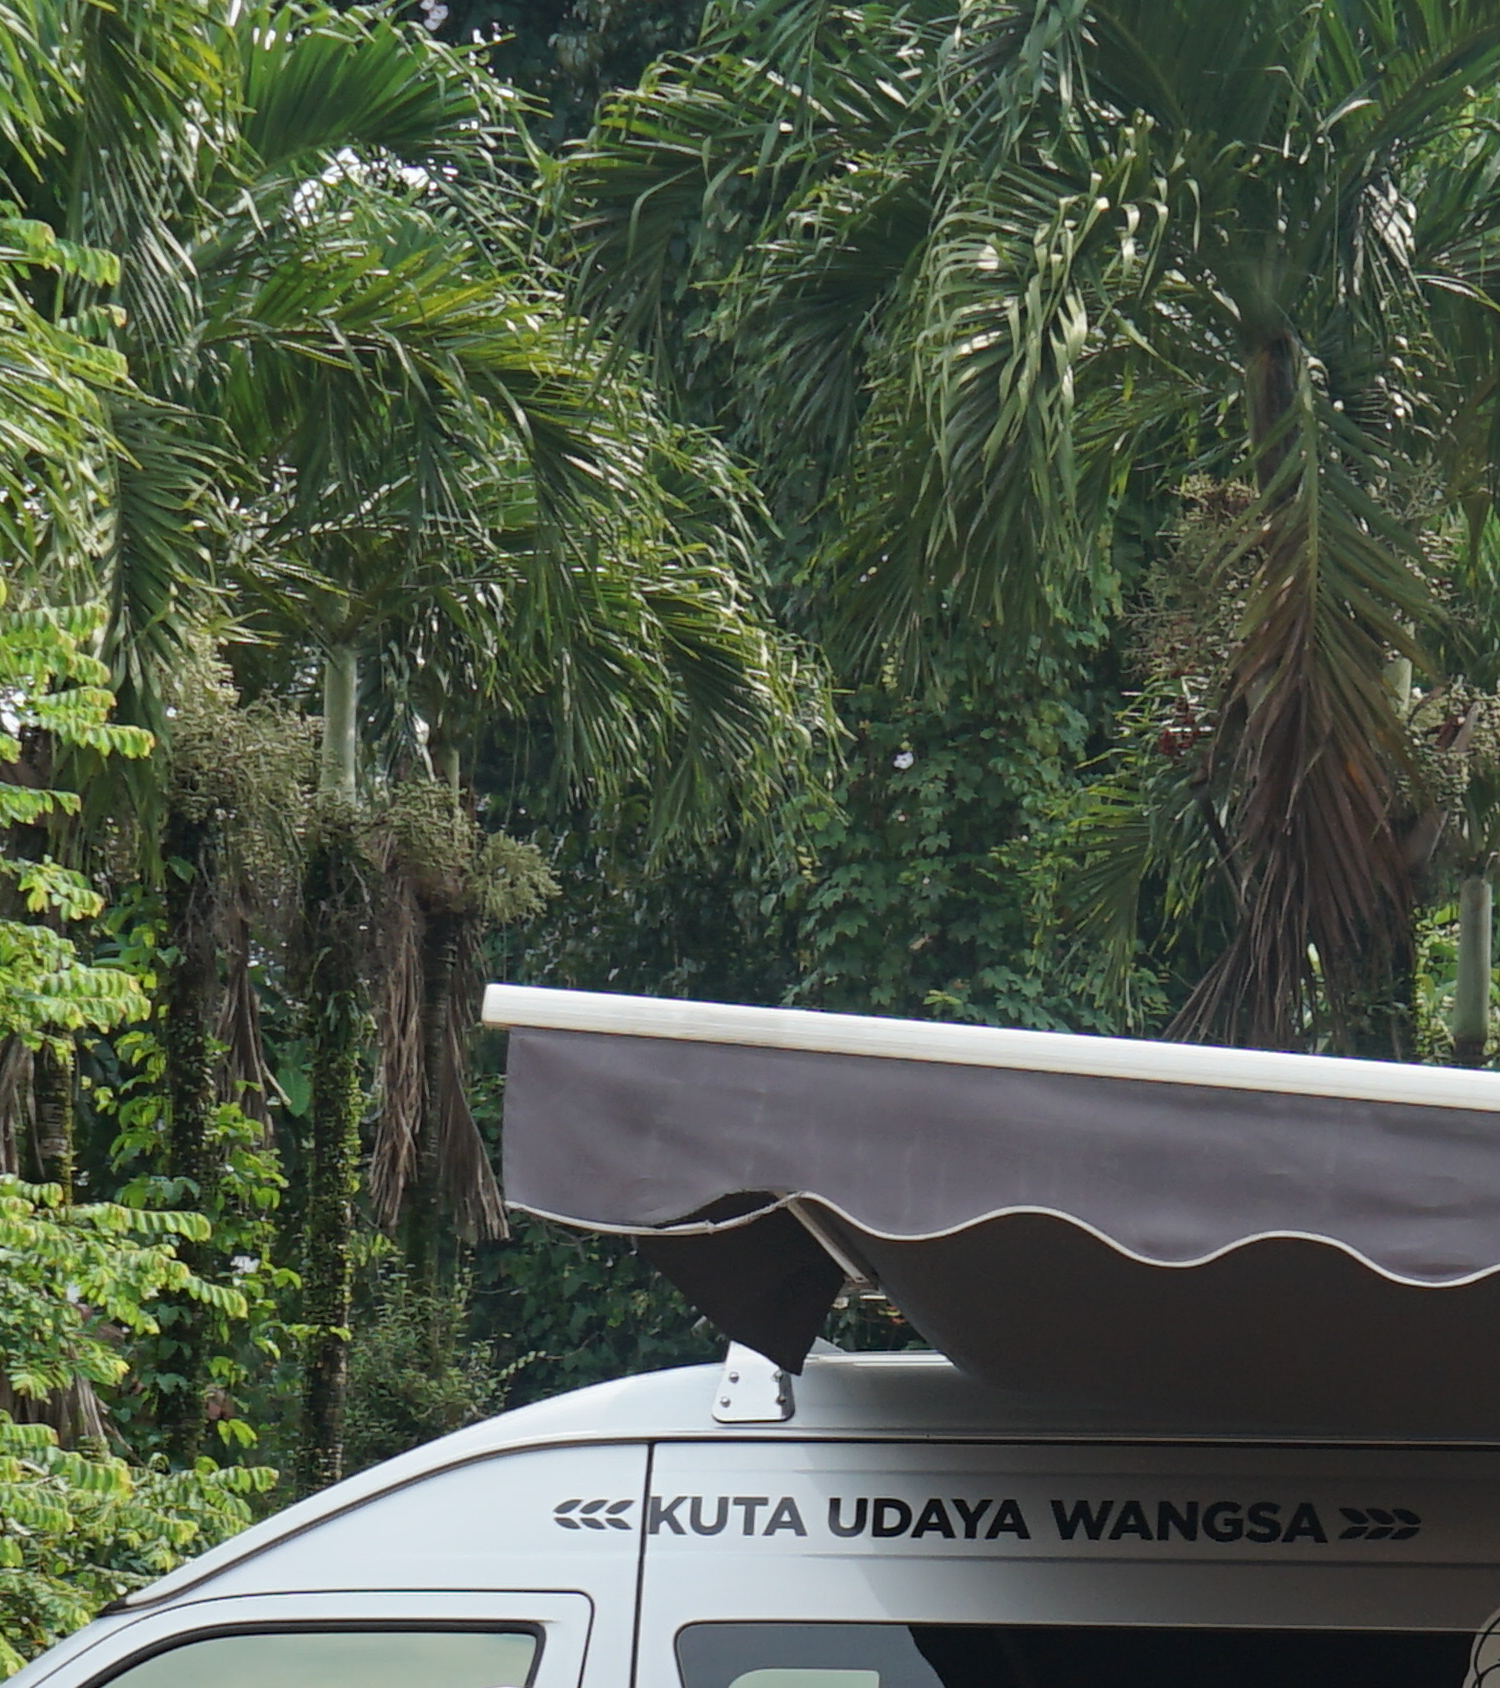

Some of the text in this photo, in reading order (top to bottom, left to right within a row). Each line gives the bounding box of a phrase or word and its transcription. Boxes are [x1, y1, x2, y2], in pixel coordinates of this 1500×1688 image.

[646, 1495, 1328, 1545] KUTA UDAYA WANGSA
